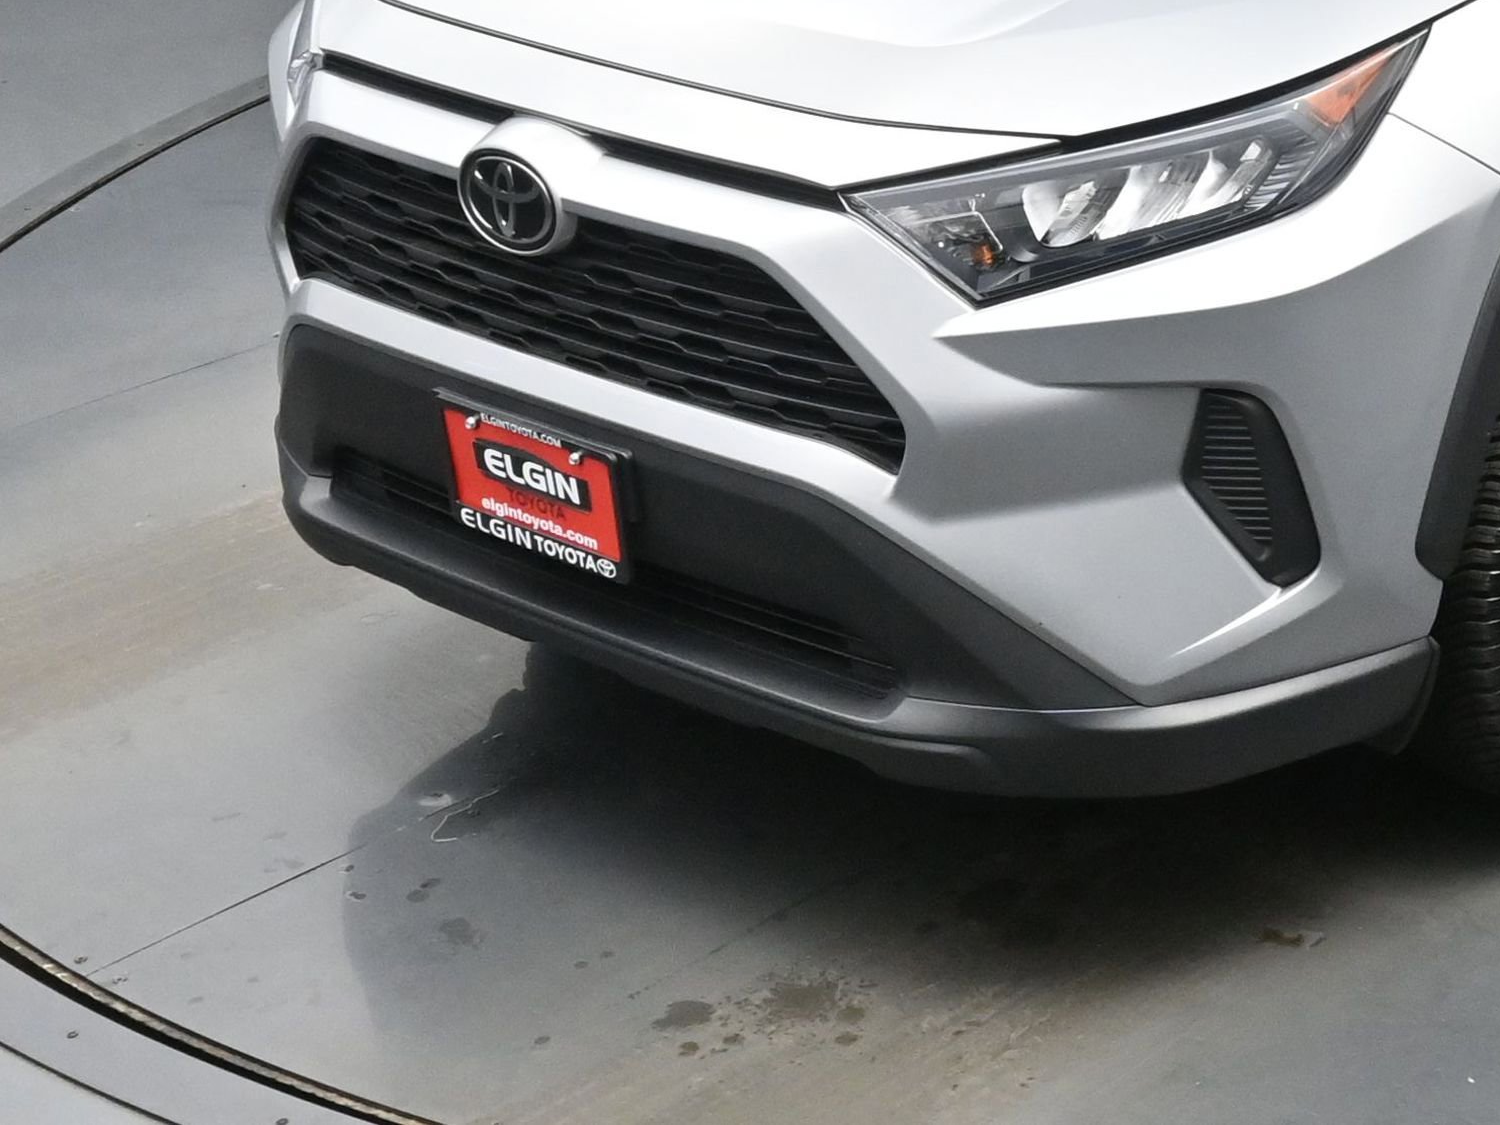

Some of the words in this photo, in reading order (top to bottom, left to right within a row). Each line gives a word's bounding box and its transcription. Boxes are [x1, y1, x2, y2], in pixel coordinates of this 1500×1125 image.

[480, 412, 562, 448] ELGINTOYOTA.COM
[483, 448, 581, 505] ELGIN
[481, 497, 598, 550] elgintoyota.com
[508, 487, 567, 521] TOYOTA
[460, 507, 532, 550] ELGIN
[534, 534, 598, 573] TOYOTA
